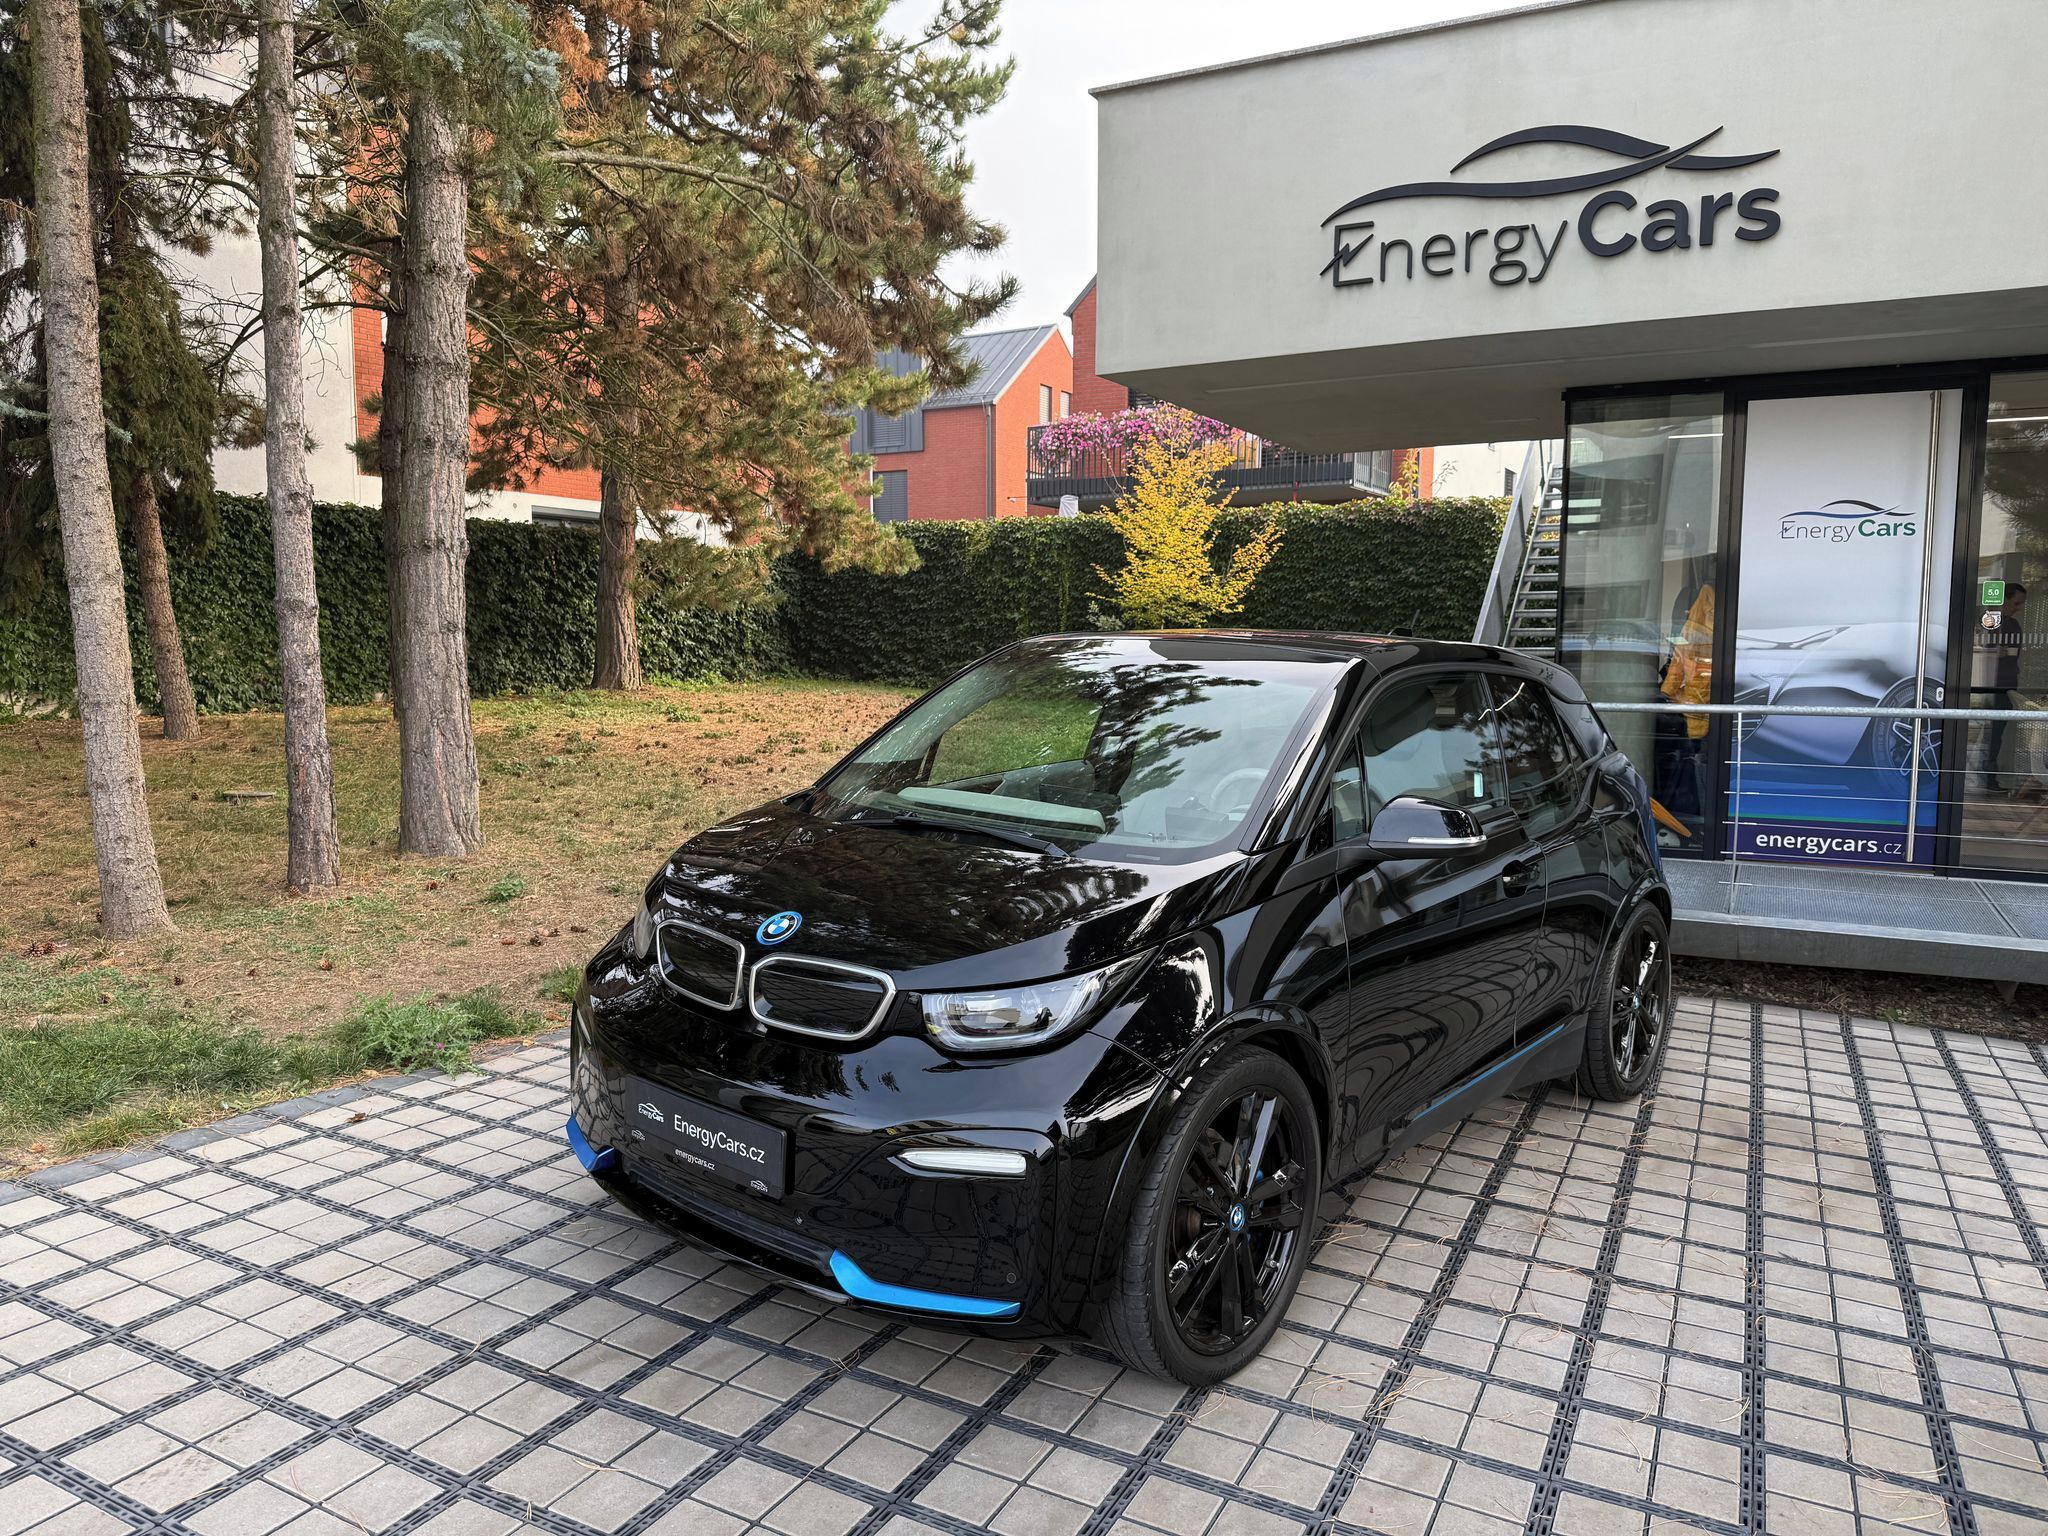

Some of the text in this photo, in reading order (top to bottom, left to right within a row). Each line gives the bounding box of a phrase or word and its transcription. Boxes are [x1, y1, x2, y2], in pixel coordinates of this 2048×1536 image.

[1756, 834, 1902, 855] energycars.cz
[674, 1114, 765, 1164] EnergyCars.cz
[675, 1149, 716, 1170] energycars.cz
